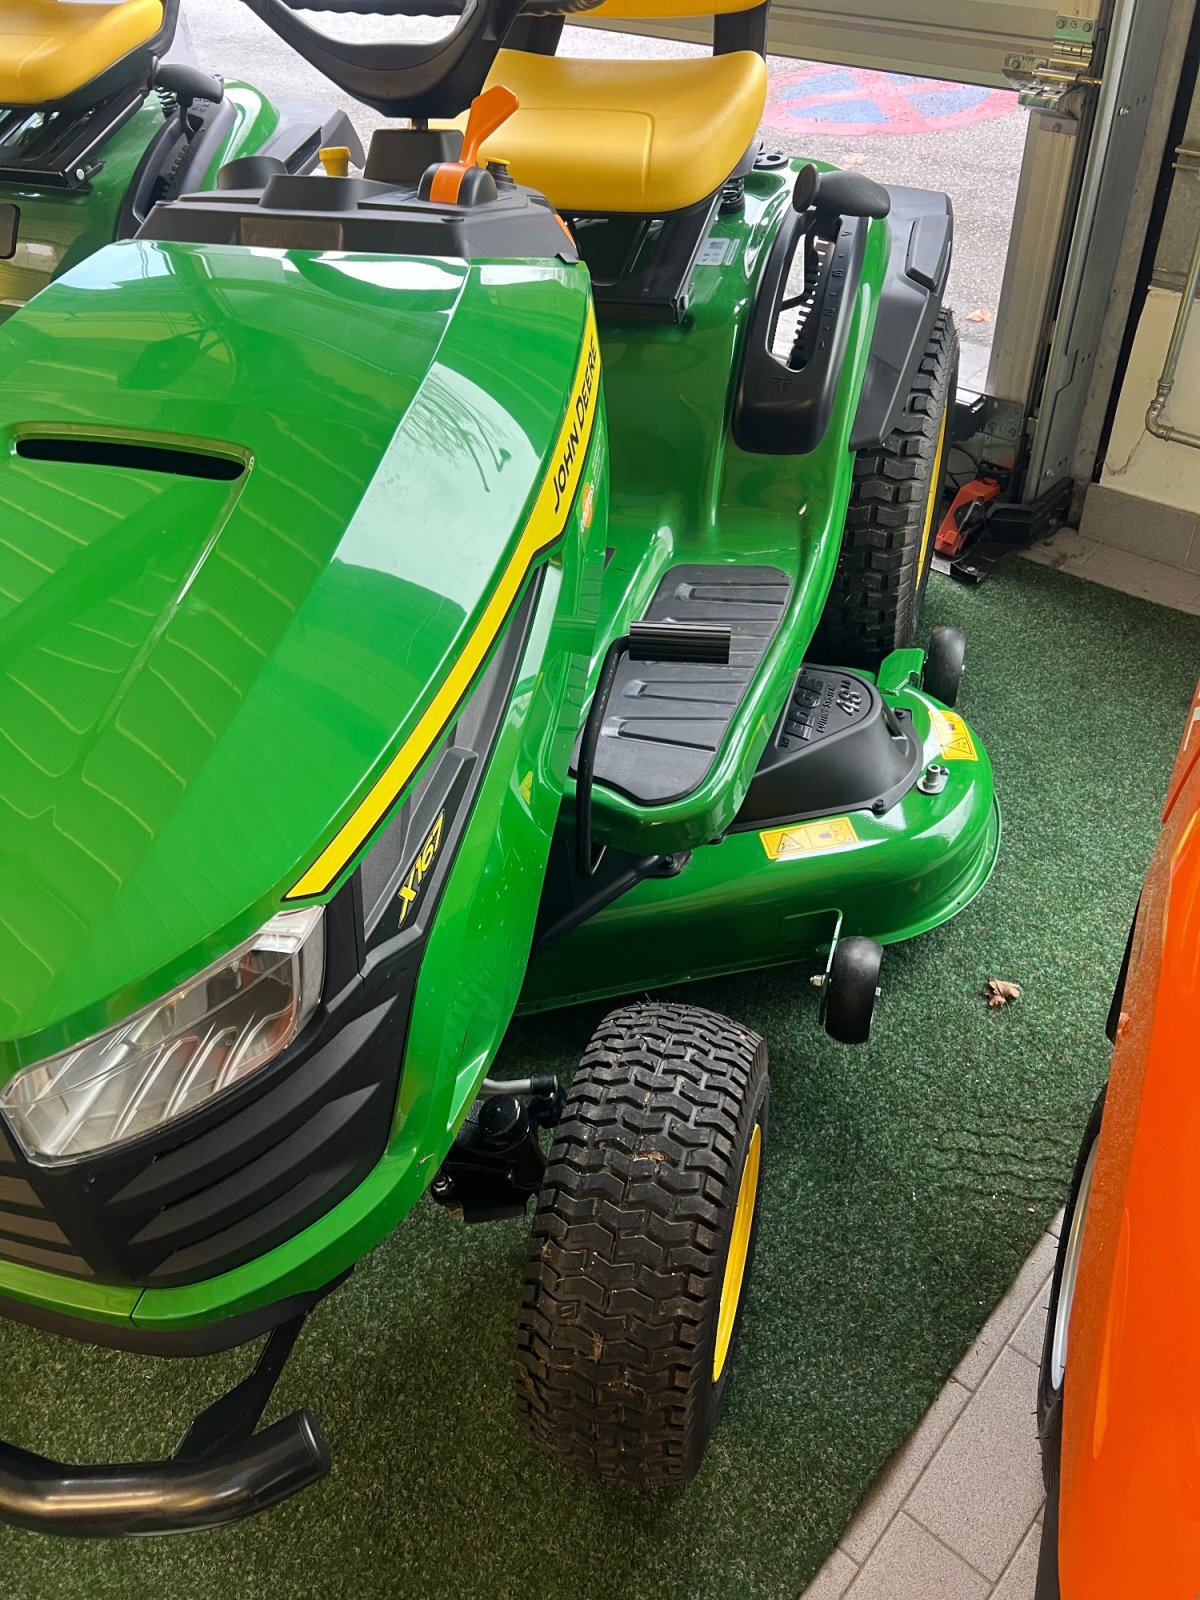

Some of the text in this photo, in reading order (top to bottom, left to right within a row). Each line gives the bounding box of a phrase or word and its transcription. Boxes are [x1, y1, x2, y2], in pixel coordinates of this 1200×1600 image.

[553, 335, 597, 514] JOHN DEERE
[785, 675, 824, 741] EDGE
[836, 680, 861, 716] 48"
[398, 809, 445, 928] X167
